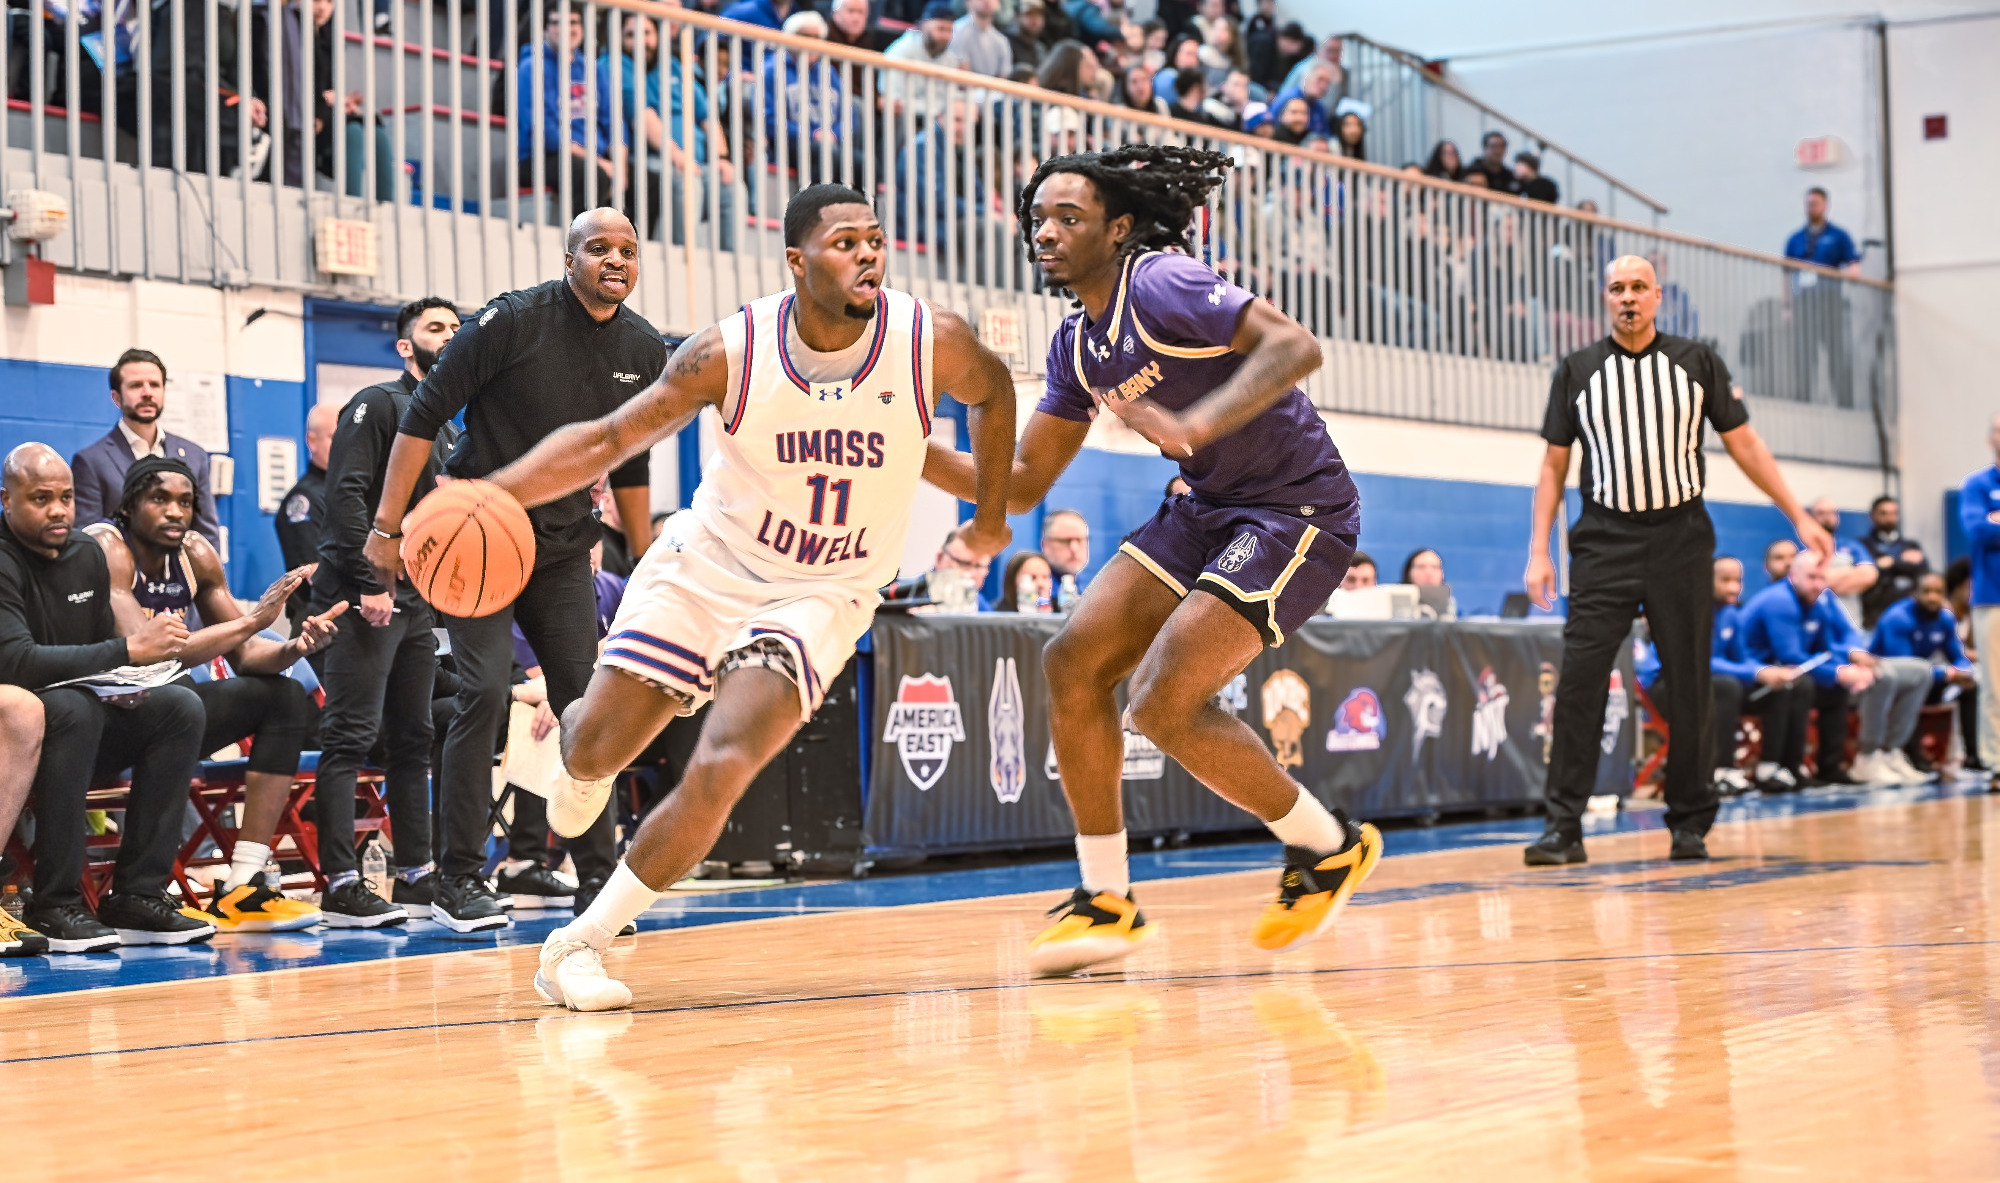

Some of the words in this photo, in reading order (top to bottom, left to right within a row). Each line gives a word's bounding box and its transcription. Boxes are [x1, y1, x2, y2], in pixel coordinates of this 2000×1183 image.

[335, 222, 367, 268] EXIT
[776, 428, 885, 468] UMASS
[807, 473, 852, 526] 11
[756, 509, 868, 565] LOWELL
[890, 708, 959, 735] AMERICA
[906, 733, 946, 753] EAST
